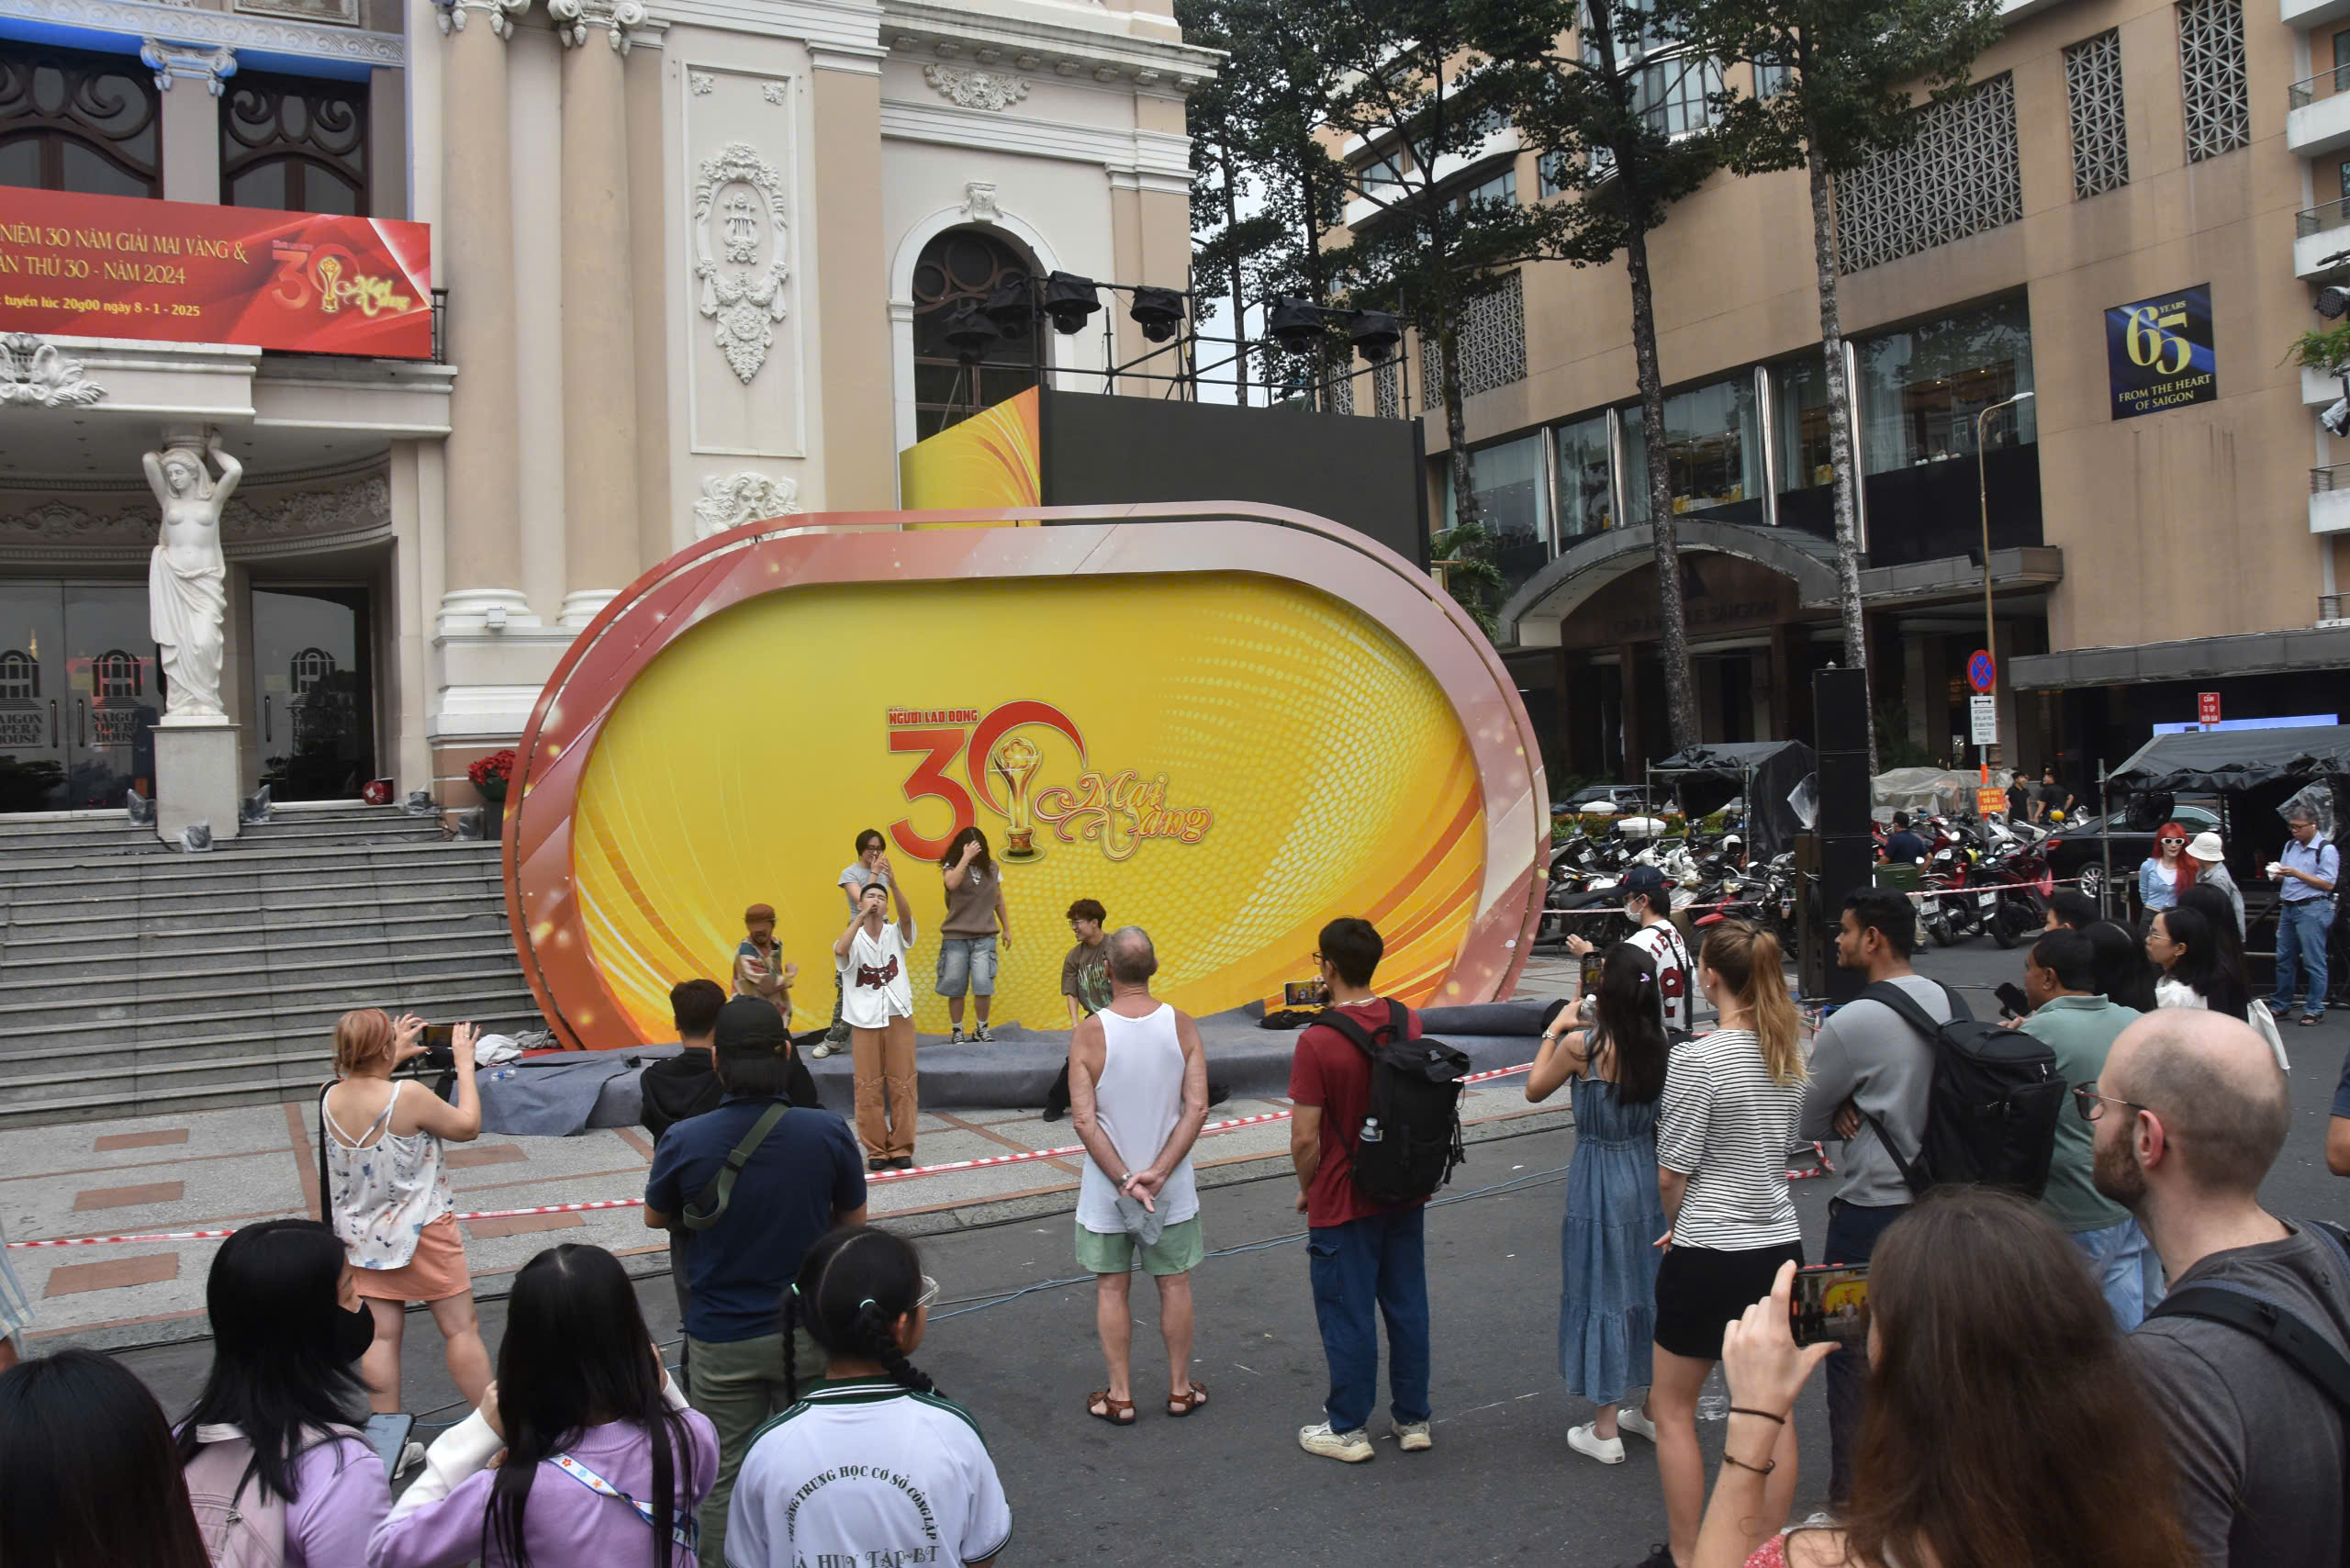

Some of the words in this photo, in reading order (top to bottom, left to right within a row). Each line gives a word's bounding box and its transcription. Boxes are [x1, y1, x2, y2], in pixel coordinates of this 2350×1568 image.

[46, 228, 71, 247] 30
[75, 228, 111, 250] NĂM
[117, 227, 147, 252] GIẢI
[153, 235, 180, 255] MAI
[185, 234, 229, 259] VÀNG
[234, 241, 249, 264] &
[25, 253, 61, 276] THỨ
[65, 259, 89, 279] 30
[104, 259, 140, 281] NĂM
[144, 264, 186, 285] 2024
[41, 296, 60, 308] lúc
[63, 297, 100, 313] 20g00
[103, 301, 131, 315] ngày
[134, 302, 142, 313] 8
[153, 303, 161, 314] 1
[172, 304, 201, 316] 2025
[2159, 300, 2186, 313] YEARS
[2126, 306, 2192, 375] 65
[2119, 388, 2149, 403] FROM
[2152, 382, 2174, 396] THE
[2176, 374, 2211, 389] HEART
[2135, 399, 2150, 411] OF
[2152, 390, 2194, 408] SAIGON
[0, 714, 43, 723] AIGON
[92, 712, 134, 722] SAIGO
[924, 710, 946, 723] LAO
[0, 723, 42, 734] PERA
[95, 722, 133, 732] OPER
[95, 733, 133, 742] HOUS
[889, 700, 1087, 862] 30
[795, 1469, 836, 1501] TRUNG
[839, 1464, 868, 1481] HỌC
[871, 1467, 890, 1481] CƠ
[890, 1473, 911, 1489] SỞ
[906, 1486, 933, 1516] CÔNG
